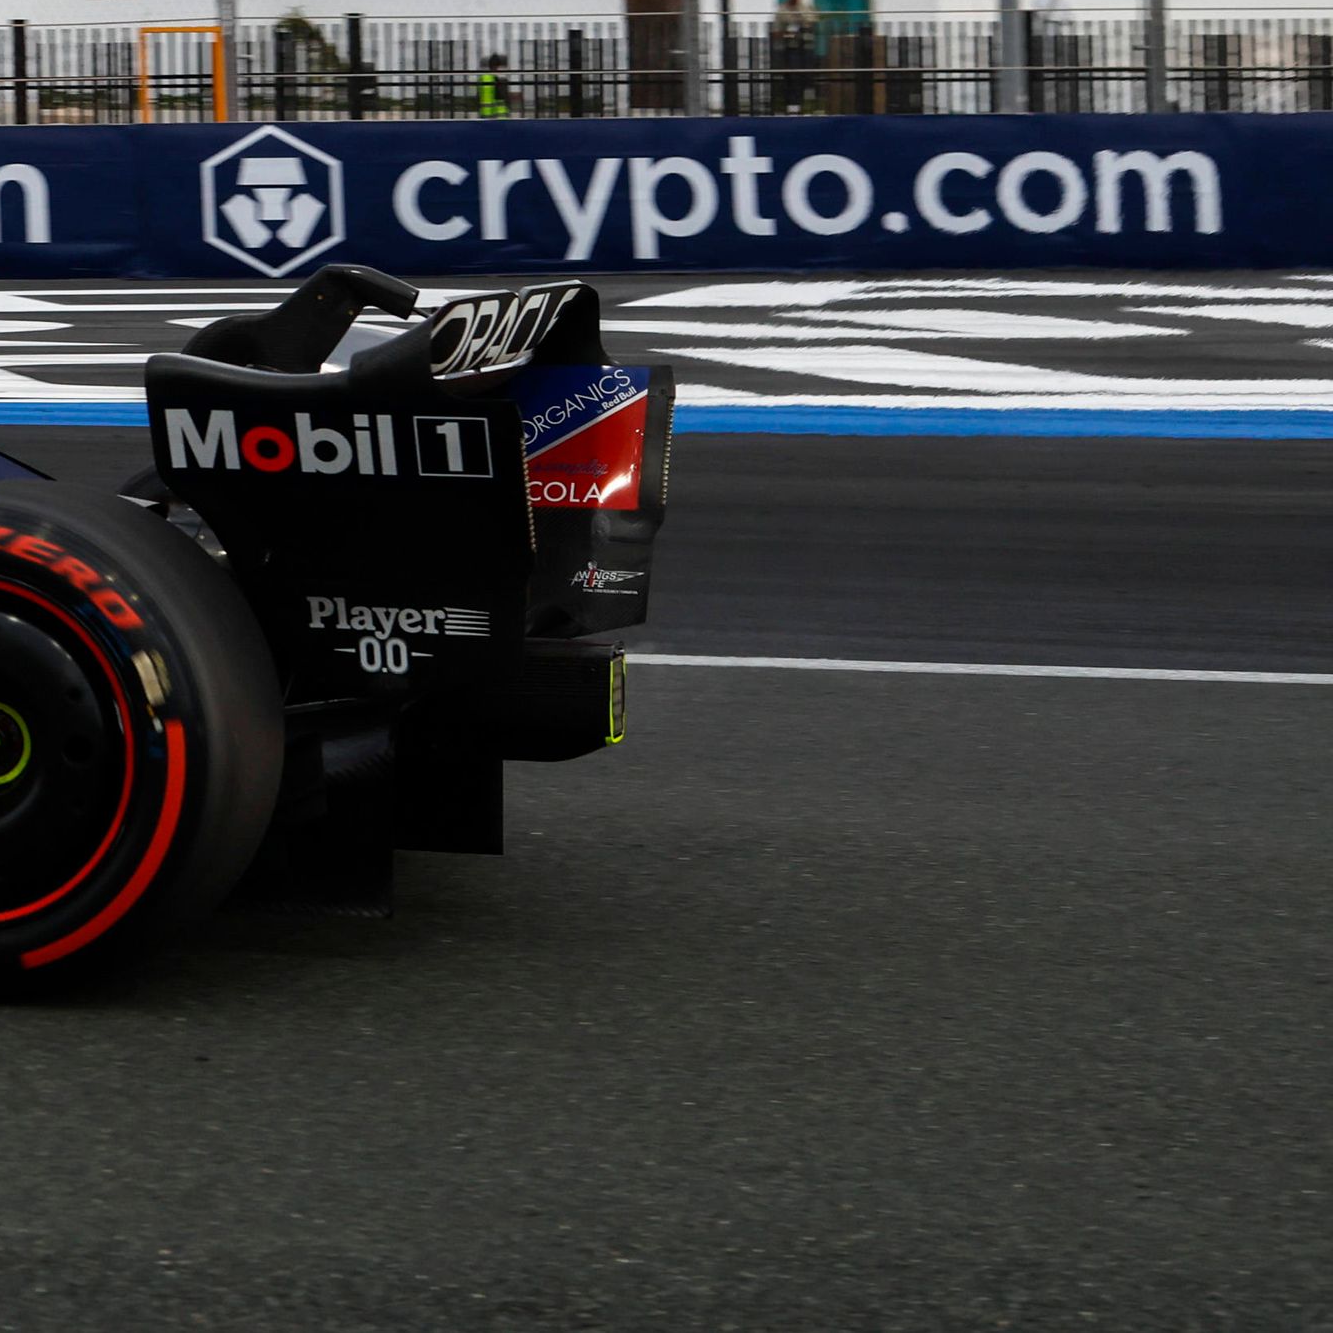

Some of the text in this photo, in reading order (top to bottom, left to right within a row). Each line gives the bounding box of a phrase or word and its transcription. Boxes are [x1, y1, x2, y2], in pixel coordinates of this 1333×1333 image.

[392, 136, 1223, 262] crypto.com
[165, 408, 465, 477] Mobil 1
[528, 481, 604, 504] COLA
[306, 596, 447, 640] Player
[359, 636, 409, 675] 0.0
